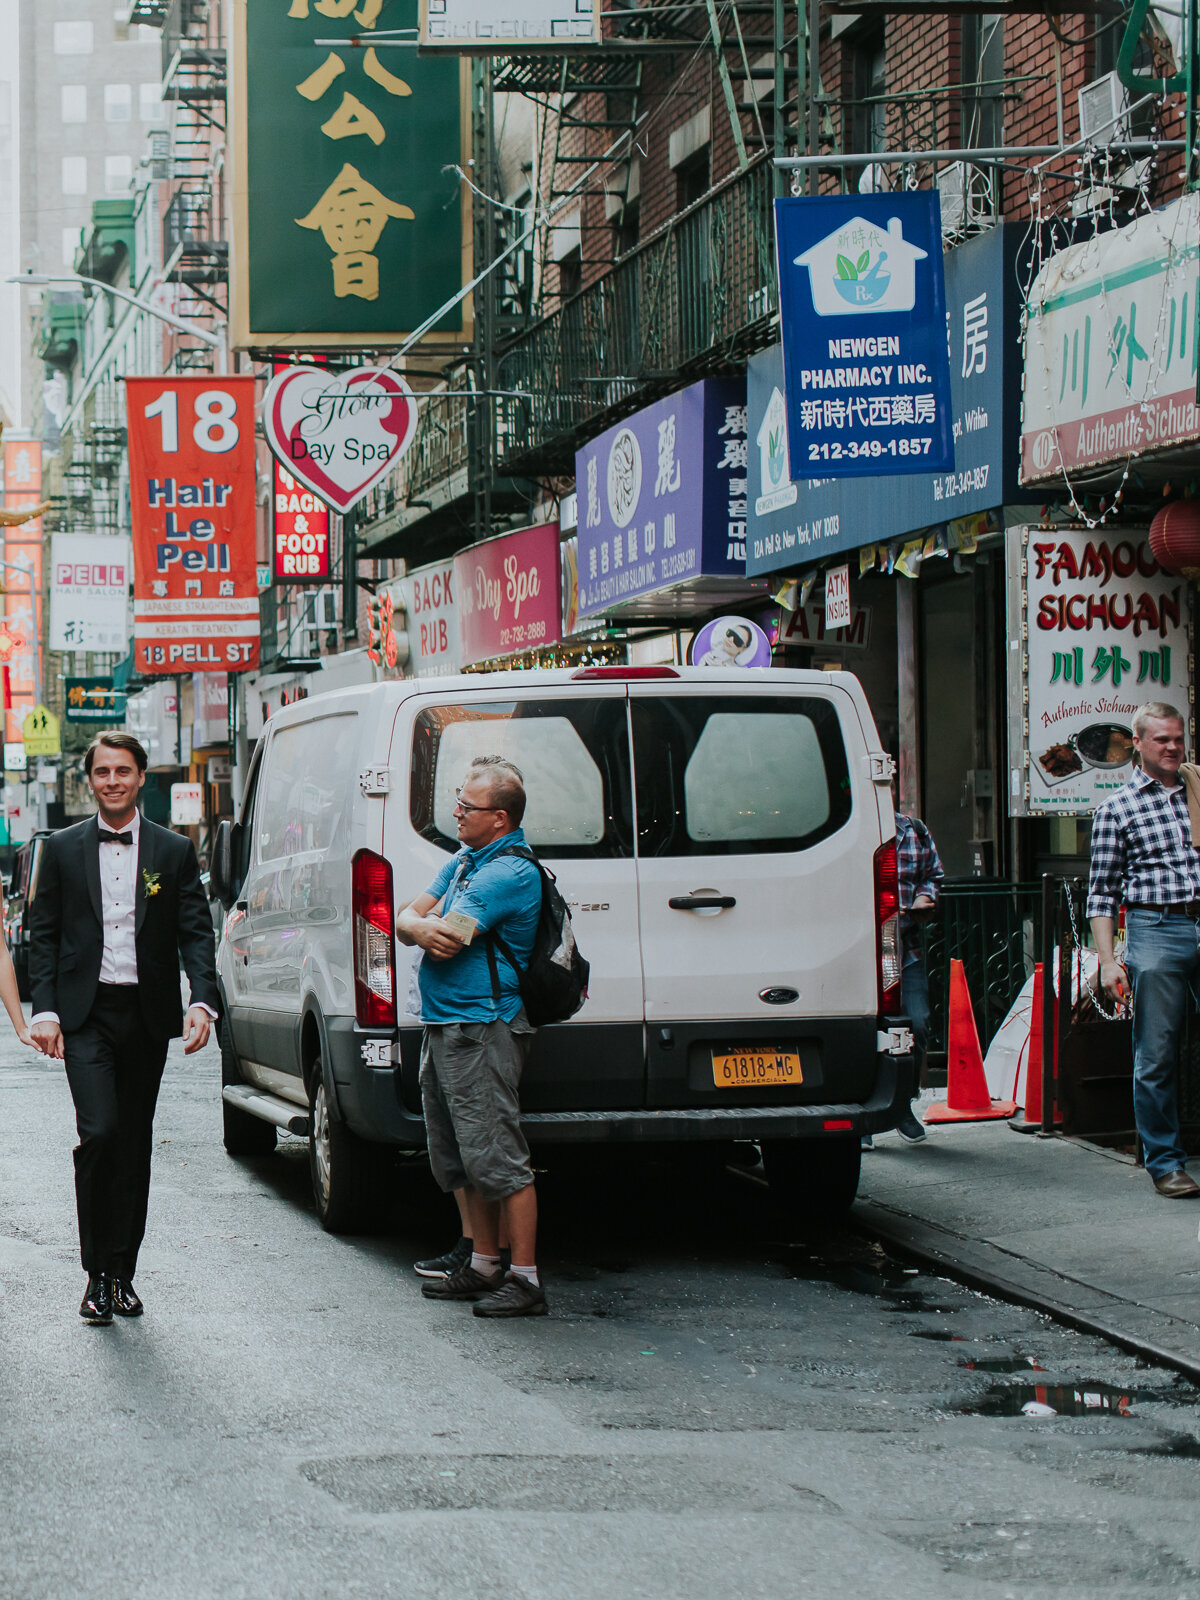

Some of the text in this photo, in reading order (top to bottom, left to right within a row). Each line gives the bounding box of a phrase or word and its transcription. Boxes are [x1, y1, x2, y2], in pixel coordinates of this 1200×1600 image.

[287, 0, 415, 300] 公會
[828, 336, 900, 359] NEWGEN
[801, 364, 932, 390] PHARMACY INC.
[144, 390, 239, 453] 18
[800, 393, 936, 431] 新時代西藥房
[964, 406, 988, 433] Within
[808, 438, 932, 461] 212-349-1857
[1076, 410, 1141, 459] Authentic
[290, 437, 391, 466] Day Spa
[148, 478, 232, 508] Hair
[933, 464, 990, 501] Tel: 212-349-1857
[275, 493, 326, 514] BACK
[165, 512, 215, 542] Le
[293, 514, 309, 534] &
[765, 534, 774, 555] Pell
[783, 530, 796, 549] New
[797, 523, 812, 546] York,
[812, 519, 822, 540] NY
[824, 514, 840, 538] 10013
[156, 543, 231, 573] Pell
[276, 534, 327, 553] FOOT
[57, 564, 124, 586] PELL
[283, 555, 320, 574] RUB
[1033, 540, 1174, 587] FAMOU
[55, 587, 125, 596] HAIR SALON
[413, 569, 453, 614] BACK
[475, 566, 503, 621] Day
[504, 555, 541, 619] Spa
[827, 571, 848, 599] ATM
[143, 600, 249, 612] JAPANESE STRAIGHTENING
[826, 599, 848, 622] INSIDE
[1037, 586, 1182, 638] SICHUAN
[155, 624, 239, 635] KERATIN TREATMENT
[420, 618, 448, 656] RUB
[785, 606, 866, 645] ATM
[142, 643, 253, 665] 18 PELL ST
[1050, 645, 1173, 686] 川外川
[1040, 695, 1139, 729] Authentic Sichuan
